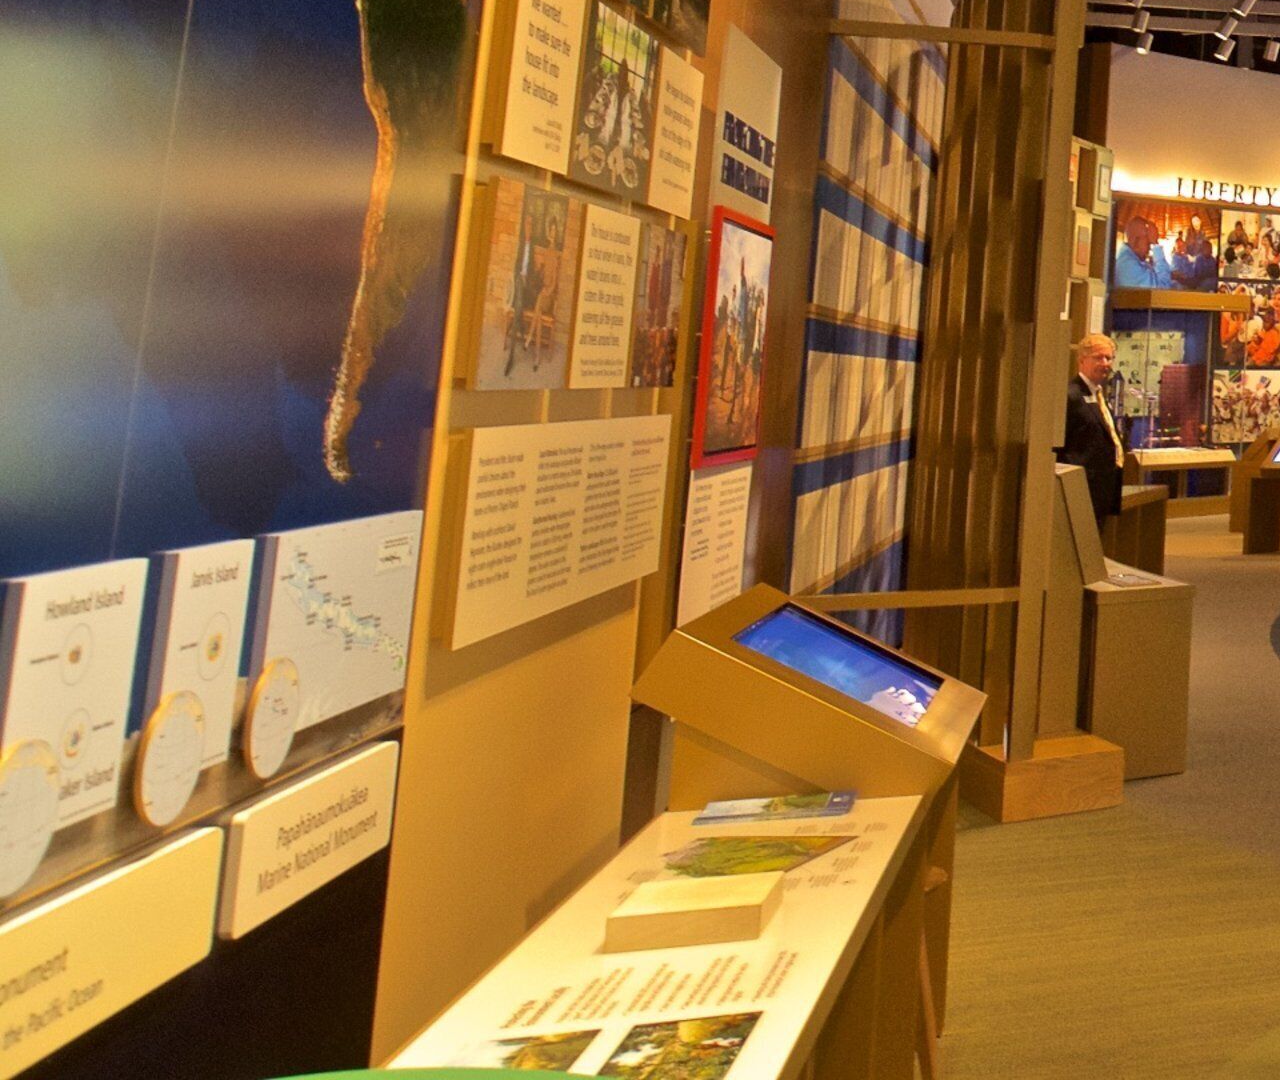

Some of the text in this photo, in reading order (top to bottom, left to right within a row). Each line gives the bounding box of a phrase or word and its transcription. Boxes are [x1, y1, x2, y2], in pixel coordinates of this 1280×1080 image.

[535, 26, 550, 46] make
[550, 34, 562, 52] sure
[562, 37, 571, 57] the
[526, 45, 542, 70] house
[522, 75, 531, 94] the
[1176, 177, 1280, 205] LIBERTY
[191, 559, 239, 589] Jarvis Island
[46, 584, 126, 621] Howland Island
[84, 762, 115, 793] Island
[257, 810, 378, 895] Marine National Monument
[68, 979, 103, 1012] Ocean
